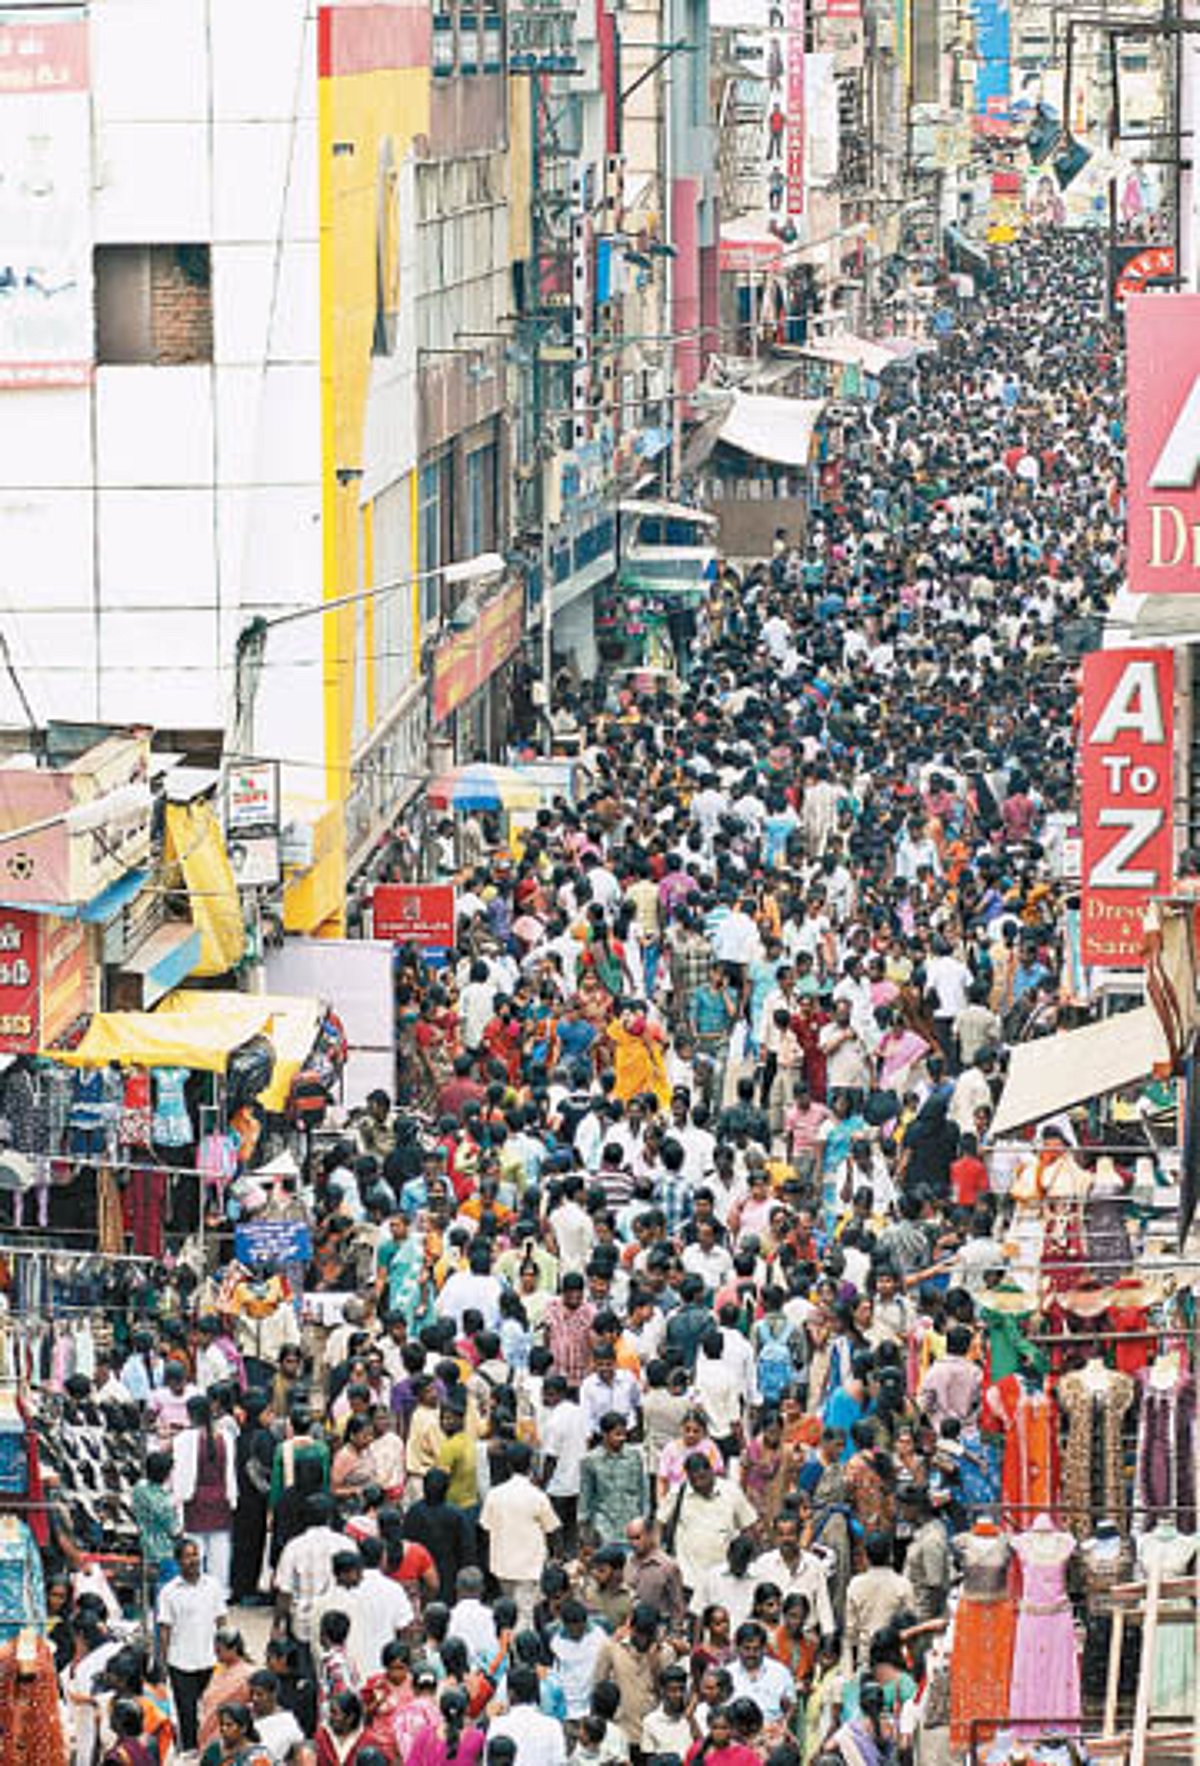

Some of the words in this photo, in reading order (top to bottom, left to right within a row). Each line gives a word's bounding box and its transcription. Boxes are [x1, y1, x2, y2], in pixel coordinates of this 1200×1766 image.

[1090, 660, 1167, 746] A
[1102, 755, 1158, 795] To
[1088, 808, 1165, 890] Z
